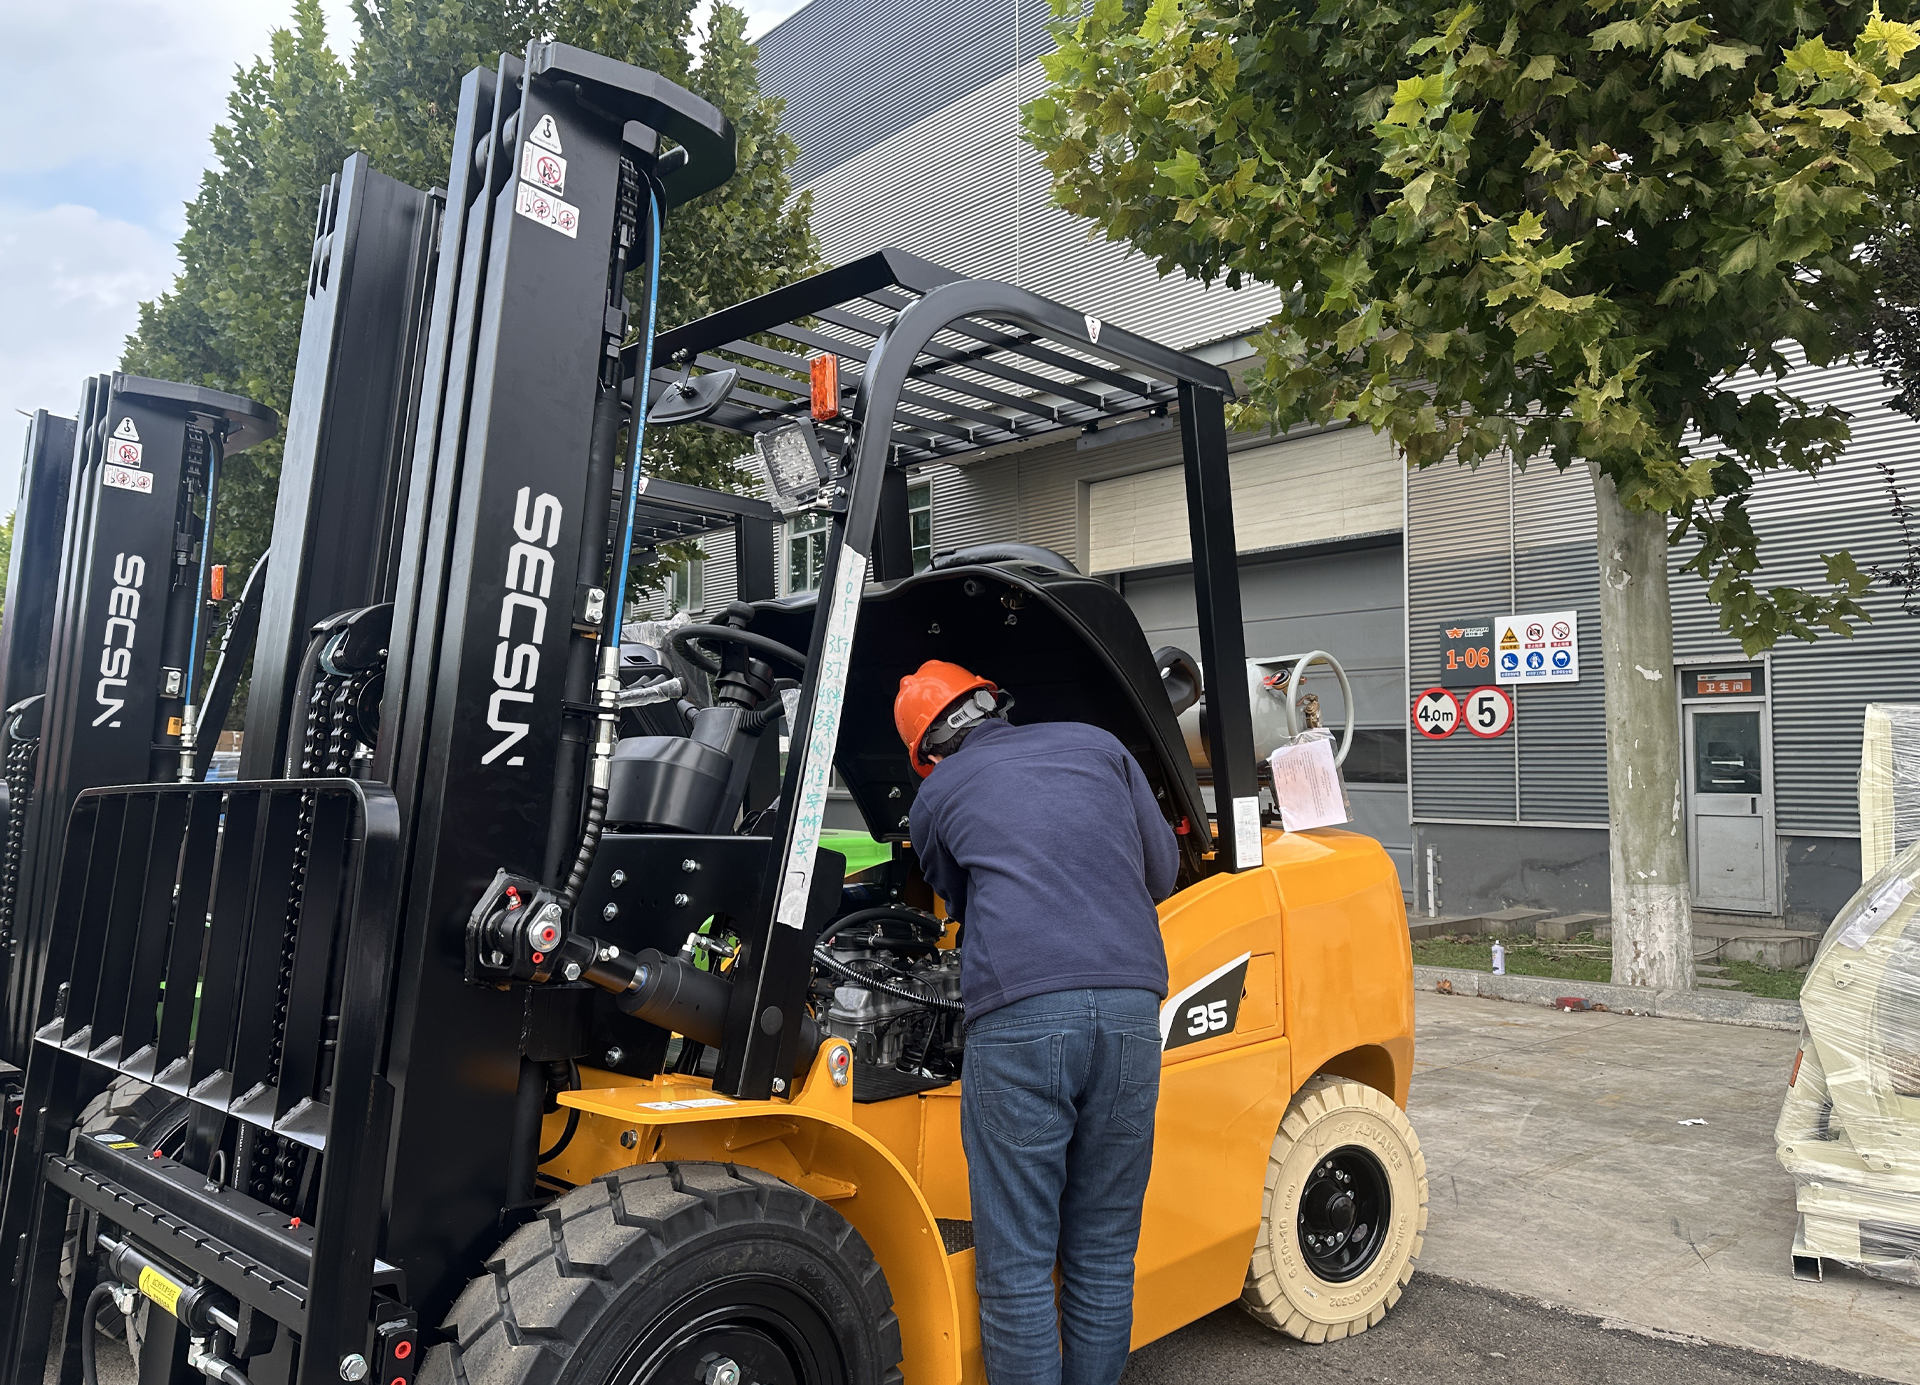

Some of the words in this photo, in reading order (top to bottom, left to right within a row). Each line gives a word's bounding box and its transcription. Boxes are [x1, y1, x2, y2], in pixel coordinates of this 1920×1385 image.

[92, 552, 146, 728] SECSUN
[481, 486, 563, 767] SECSUN
[1446, 647, 1490, 670] 1-06
[1705, 681, 1744, 693] 卫生间
[1418, 705, 1454, 722] 4.0m
[1478, 696, 1496, 728] 5
[1186, 999, 1228, 1037] 35
[1356, 1122, 1403, 1171] ADVANCE
[1279, 1218, 1298, 1279] 6.50-10
